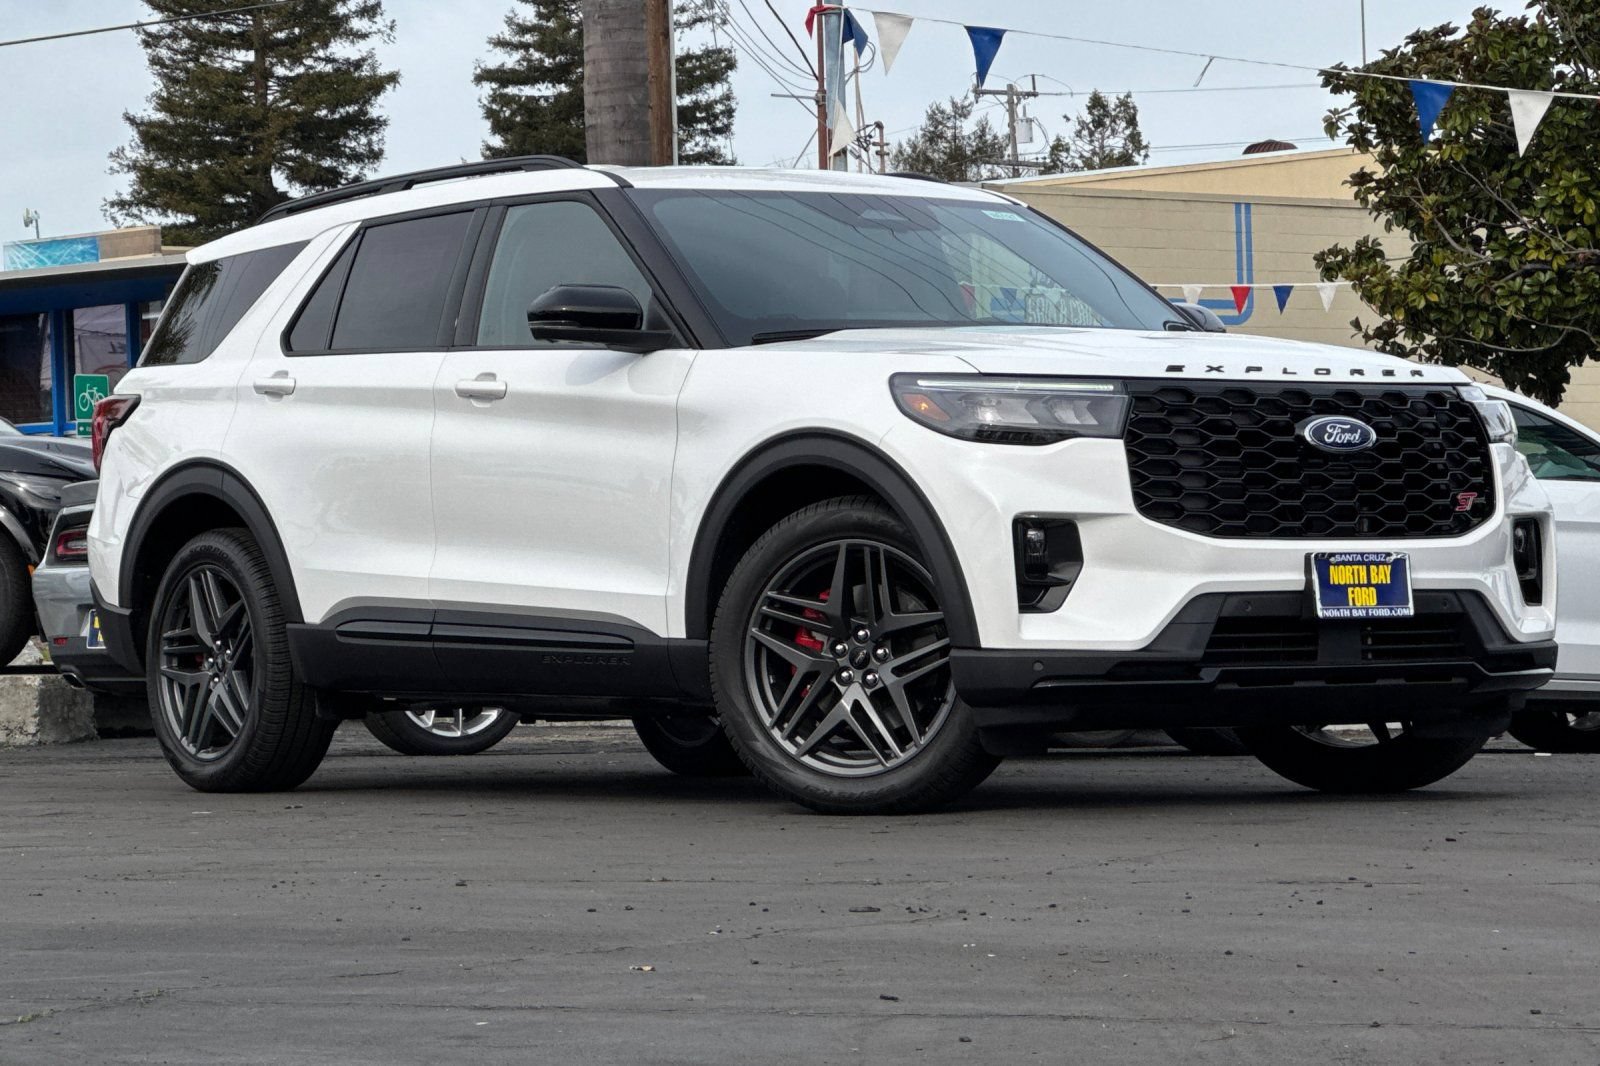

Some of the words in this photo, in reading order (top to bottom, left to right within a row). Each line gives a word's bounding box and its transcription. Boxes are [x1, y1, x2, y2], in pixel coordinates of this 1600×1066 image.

[1165, 364, 1424, 377] EXPLORER
[1324, 423, 1362, 444] Ford
[1455, 492, 1478, 511] ST
[1335, 554, 1362, 562] SANTA
[1363, 553, 1386, 562] CRUZ
[1329, 565, 1367, 585] NORTH
[1369, 564, 1391, 584] BAY
[1347, 587, 1377, 607] FORD
[1323, 608, 1351, 617] NORTH
[1352, 608, 1367, 617] BAY
[1368, 607, 1410, 617] FORD.COM
[541, 655, 632, 665] EXPLORER
